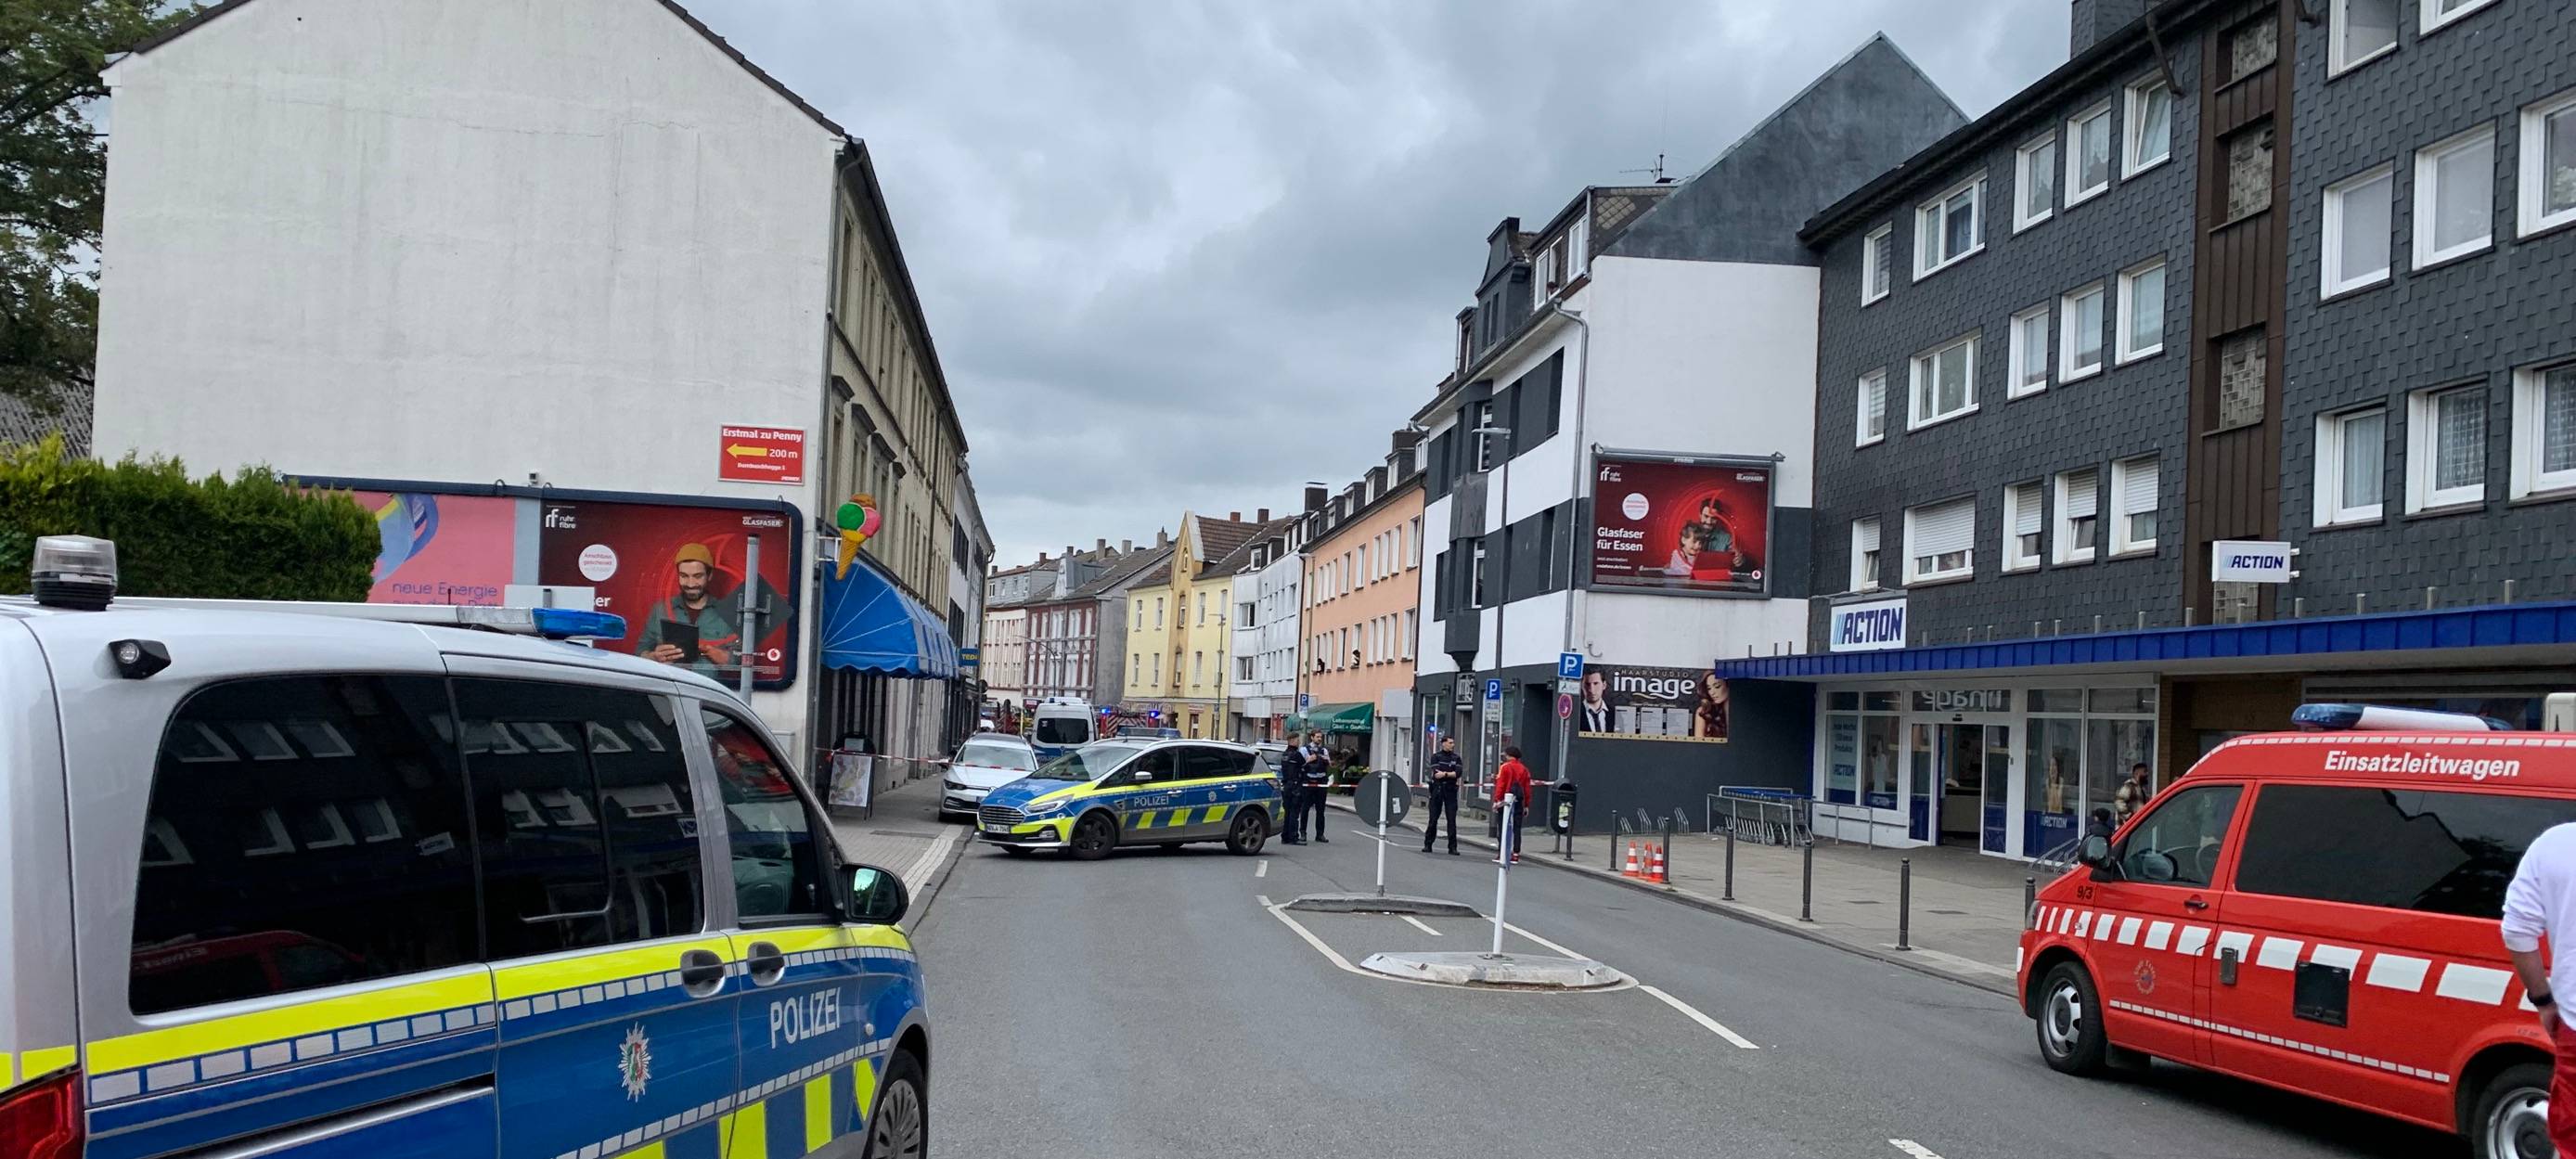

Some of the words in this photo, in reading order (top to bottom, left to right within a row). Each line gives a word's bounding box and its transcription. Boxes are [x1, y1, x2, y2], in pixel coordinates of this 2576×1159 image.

[723, 429, 758, 438] Erstmal
[773, 431, 802, 443] Penny
[769, 448, 786, 457] 200
[1597, 527, 1644, 539] Glasfaser
[1596, 539, 1612, 549] für
[1614, 541, 1643, 551] Essen
[2232, 556, 2284, 569] ACTION
[393, 584, 432, 595] neue
[438, 582, 498, 599] Energie
[1841, 607, 1904, 644] ACTION
[1564, 655, 1578, 675] P
[1488, 681, 1498, 698] P
[1614, 671, 1696, 700] image
[1301, 695, 1307, 705] P
[2325, 750, 2520, 780] Einsatzleitwagen
[1134, 795, 1169, 806] POLIZEI
[2044, 816, 2067, 828] ACTION
[2077, 885, 2093, 899] 9/3
[770, 987, 841, 1050] POLIZEI
